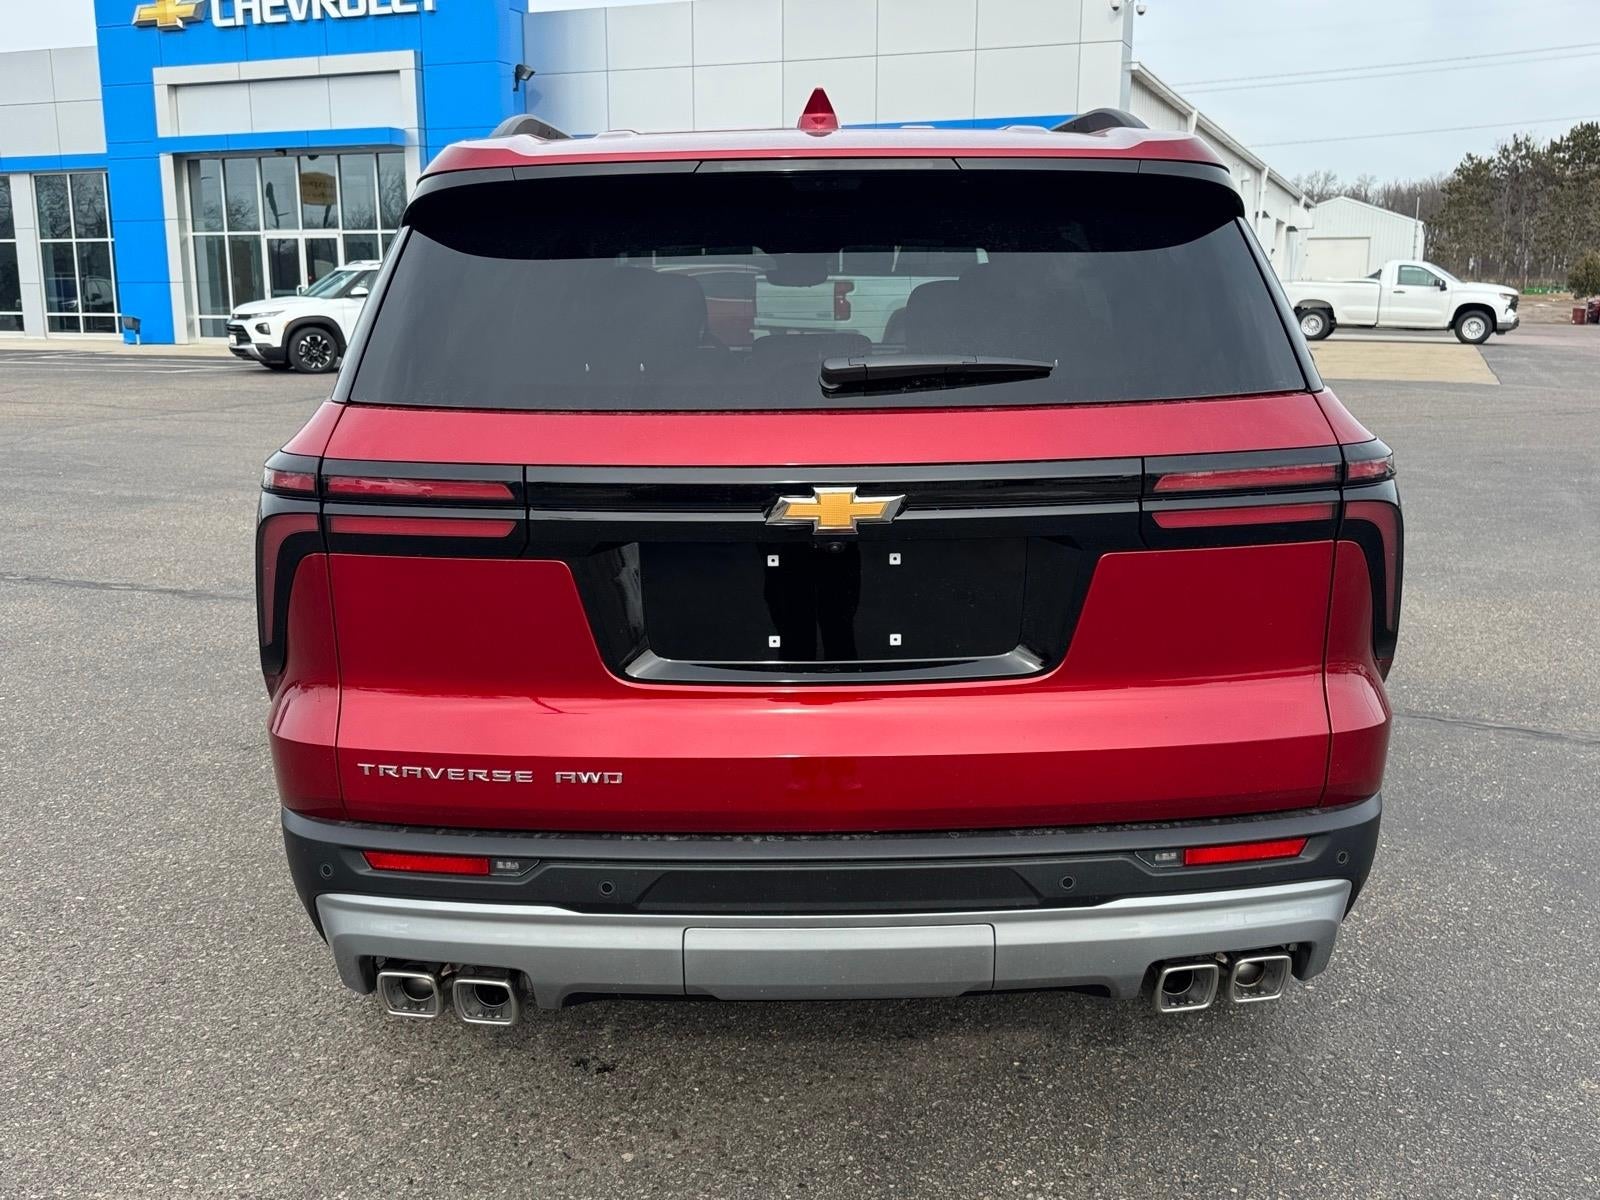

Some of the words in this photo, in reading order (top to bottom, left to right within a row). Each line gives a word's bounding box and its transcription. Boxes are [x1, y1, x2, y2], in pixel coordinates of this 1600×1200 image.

[211, 0, 437, 27] CHEVR
[357, 763, 534, 783] TRAVERSE
[555, 771, 623, 784] AWD
